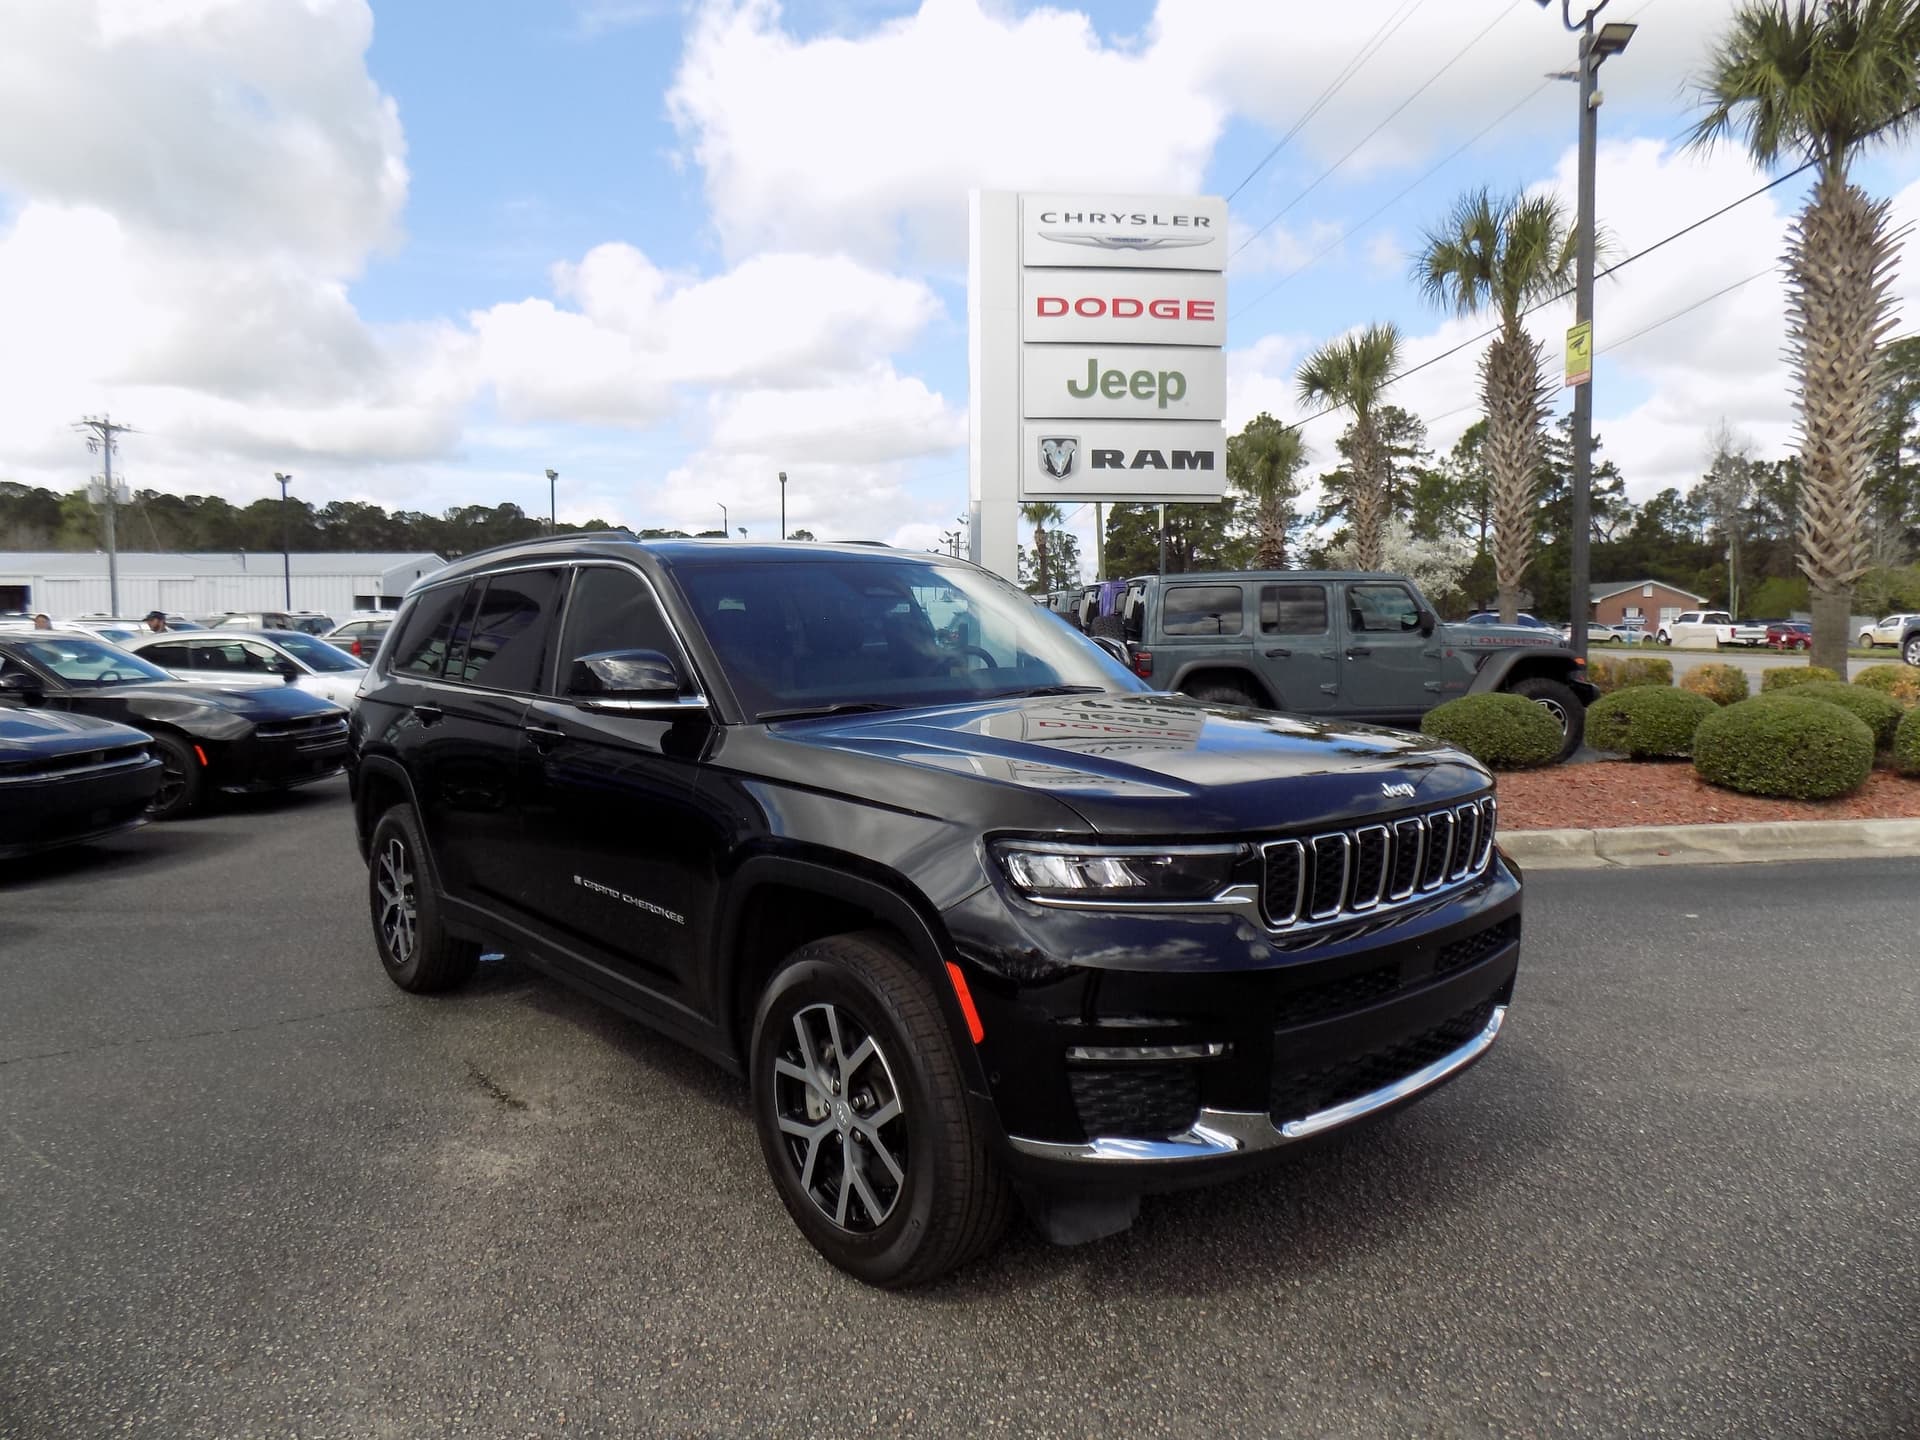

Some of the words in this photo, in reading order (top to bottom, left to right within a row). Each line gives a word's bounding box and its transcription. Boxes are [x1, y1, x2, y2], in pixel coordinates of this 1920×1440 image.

[1040, 212, 1211, 228] CHRYSLER
[1036, 296, 1216, 322] DODGE
[1066, 358, 1188, 409] Jeep
[1091, 449, 1215, 471] RAM
[1479, 636, 1553, 646] RUBICON
[1381, 782, 1416, 798] Jeep
[583, 879, 620, 899] GRAND
[622, 893, 685, 925] CHEROKEE
